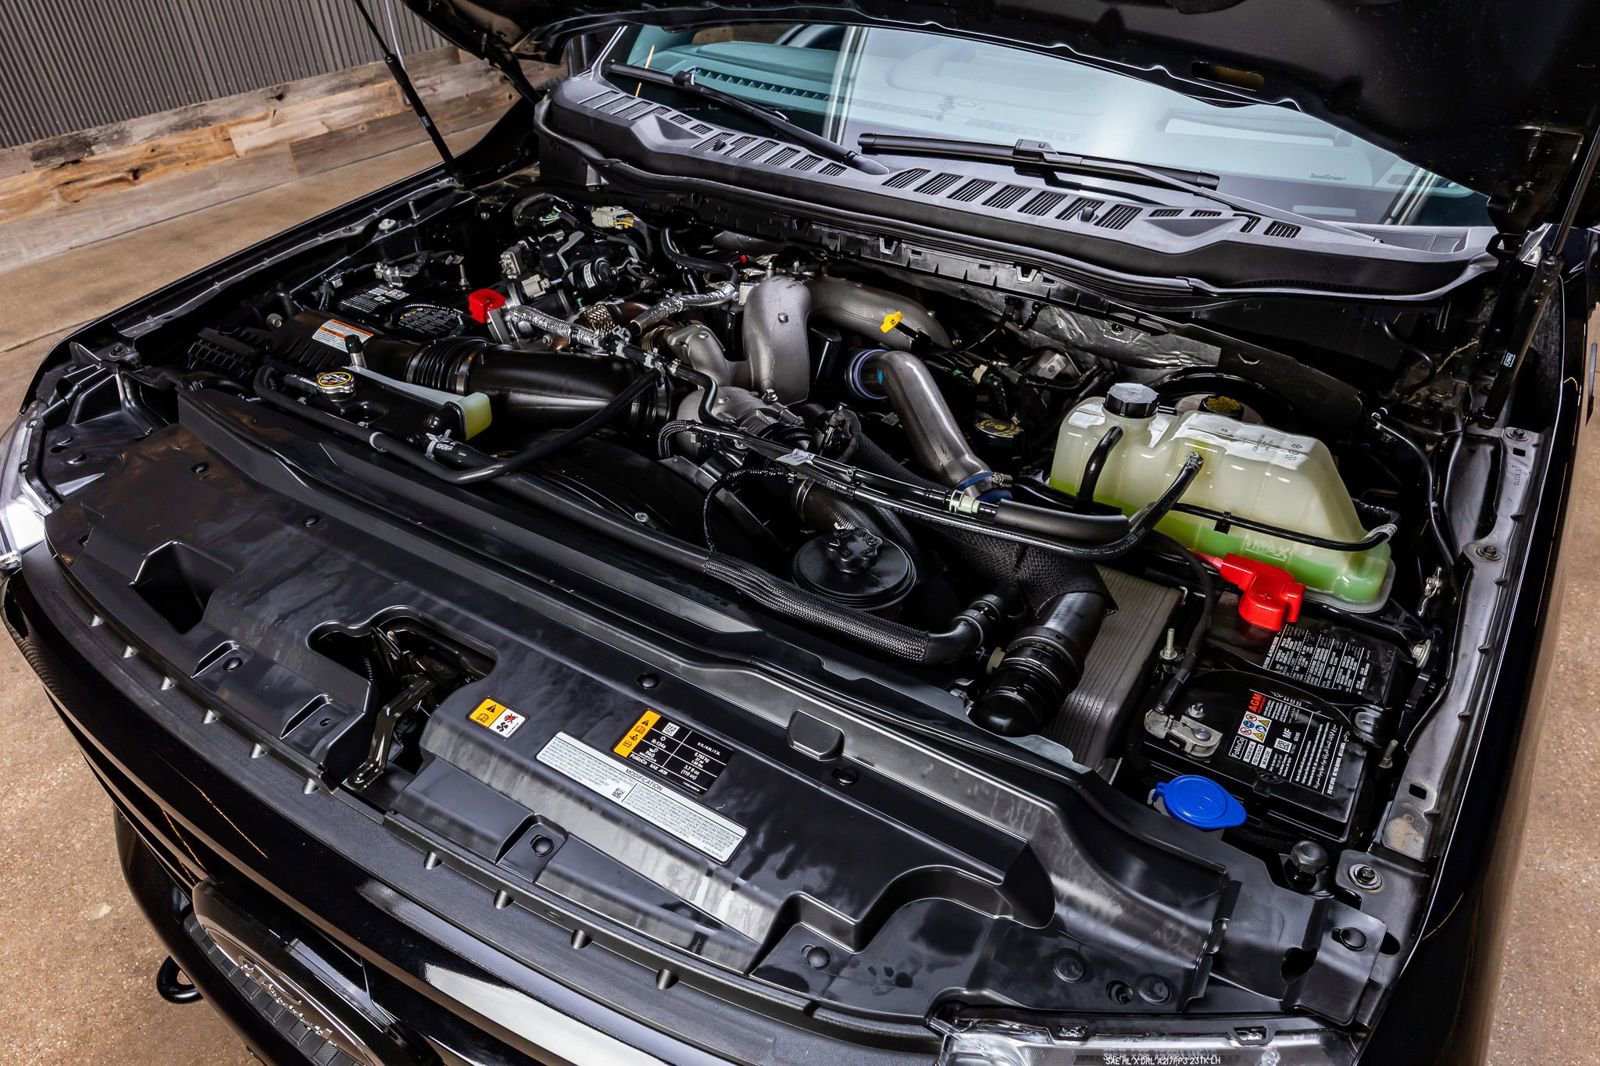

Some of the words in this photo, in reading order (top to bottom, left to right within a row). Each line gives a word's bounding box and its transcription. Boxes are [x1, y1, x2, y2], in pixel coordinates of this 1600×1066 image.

[1247, 693, 1262, 712] AGM
[1231, 738, 1245, 758] FoMoCo
[624, 768, 663, 792] MODIFICATION
[1105, 1056, 1120, 1065] SAE
[1140, 1056, 1155, 1065] DRL
